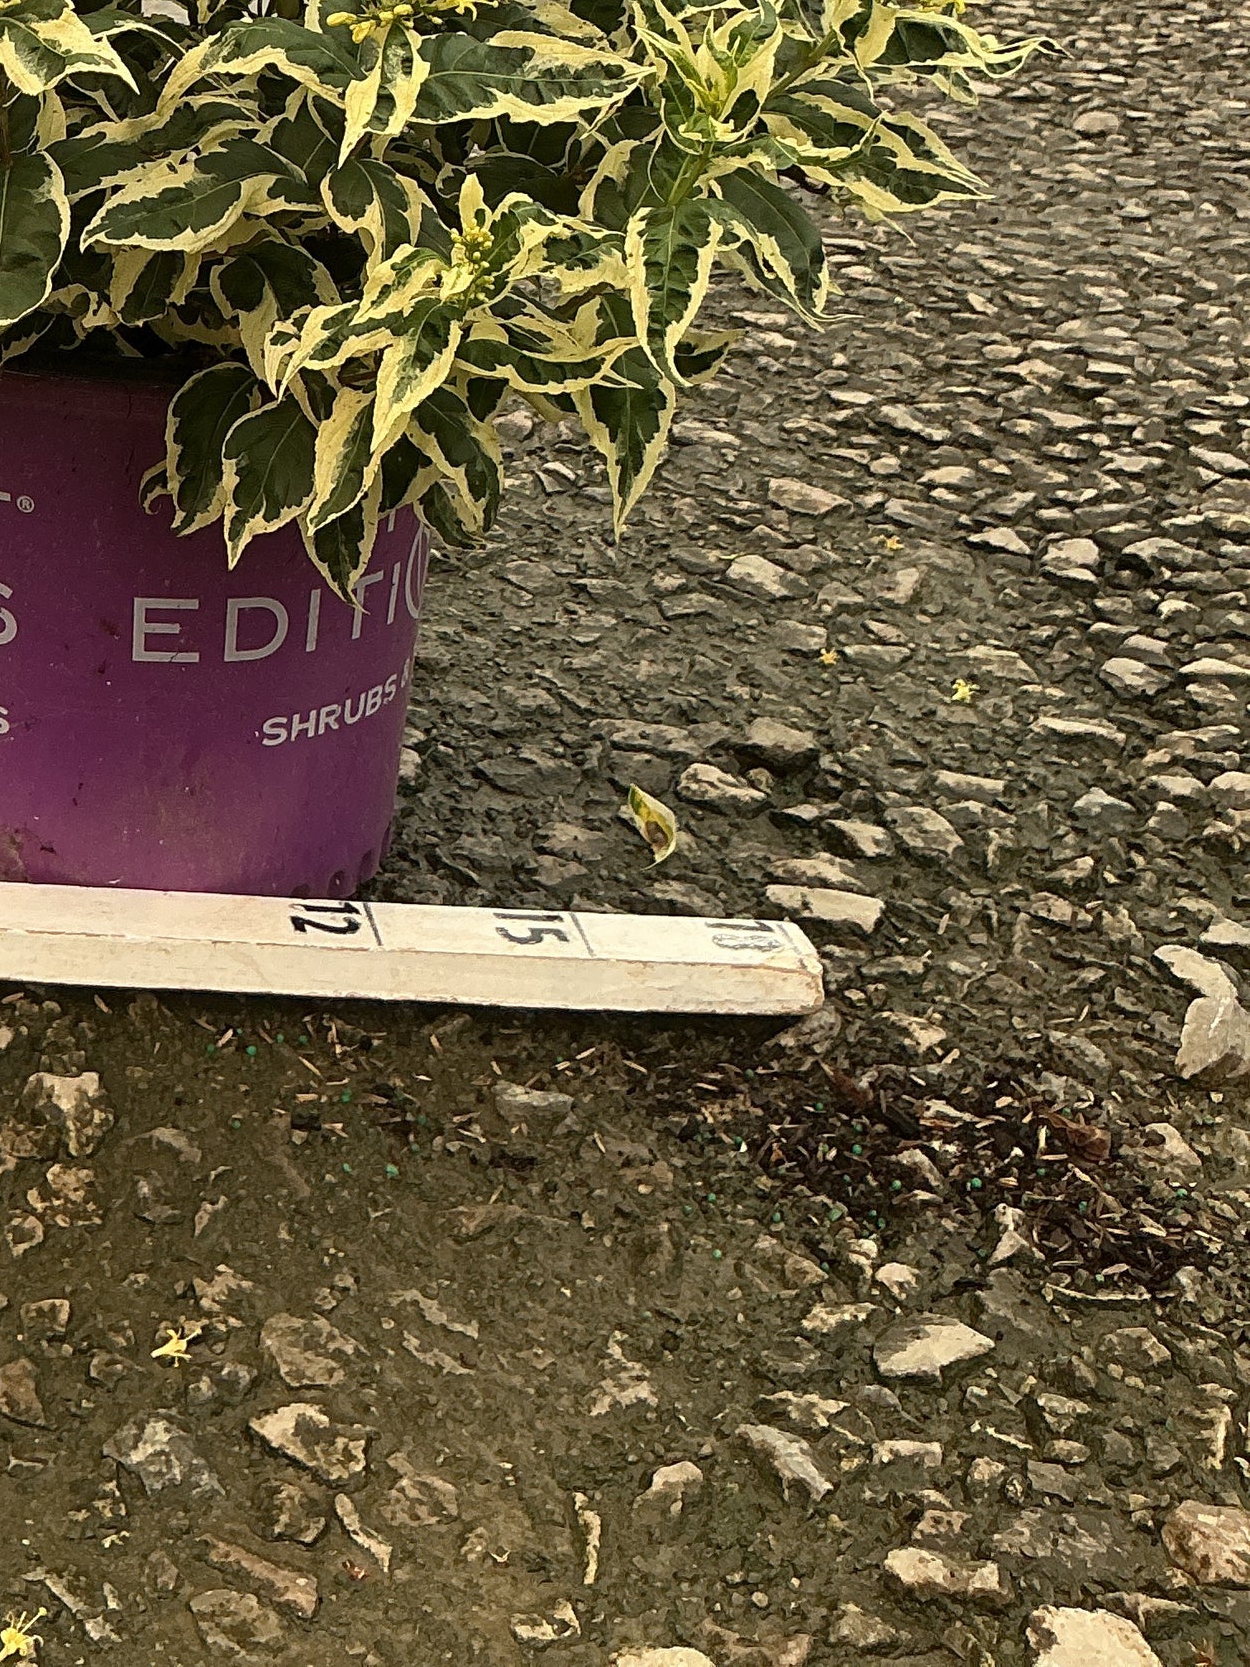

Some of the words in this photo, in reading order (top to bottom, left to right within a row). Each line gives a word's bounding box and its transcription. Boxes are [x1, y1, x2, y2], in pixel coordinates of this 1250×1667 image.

[261, 673, 399, 747] SHRUBS
[289, 901, 362, 934] 12
[493, 912, 569, 945] 15
